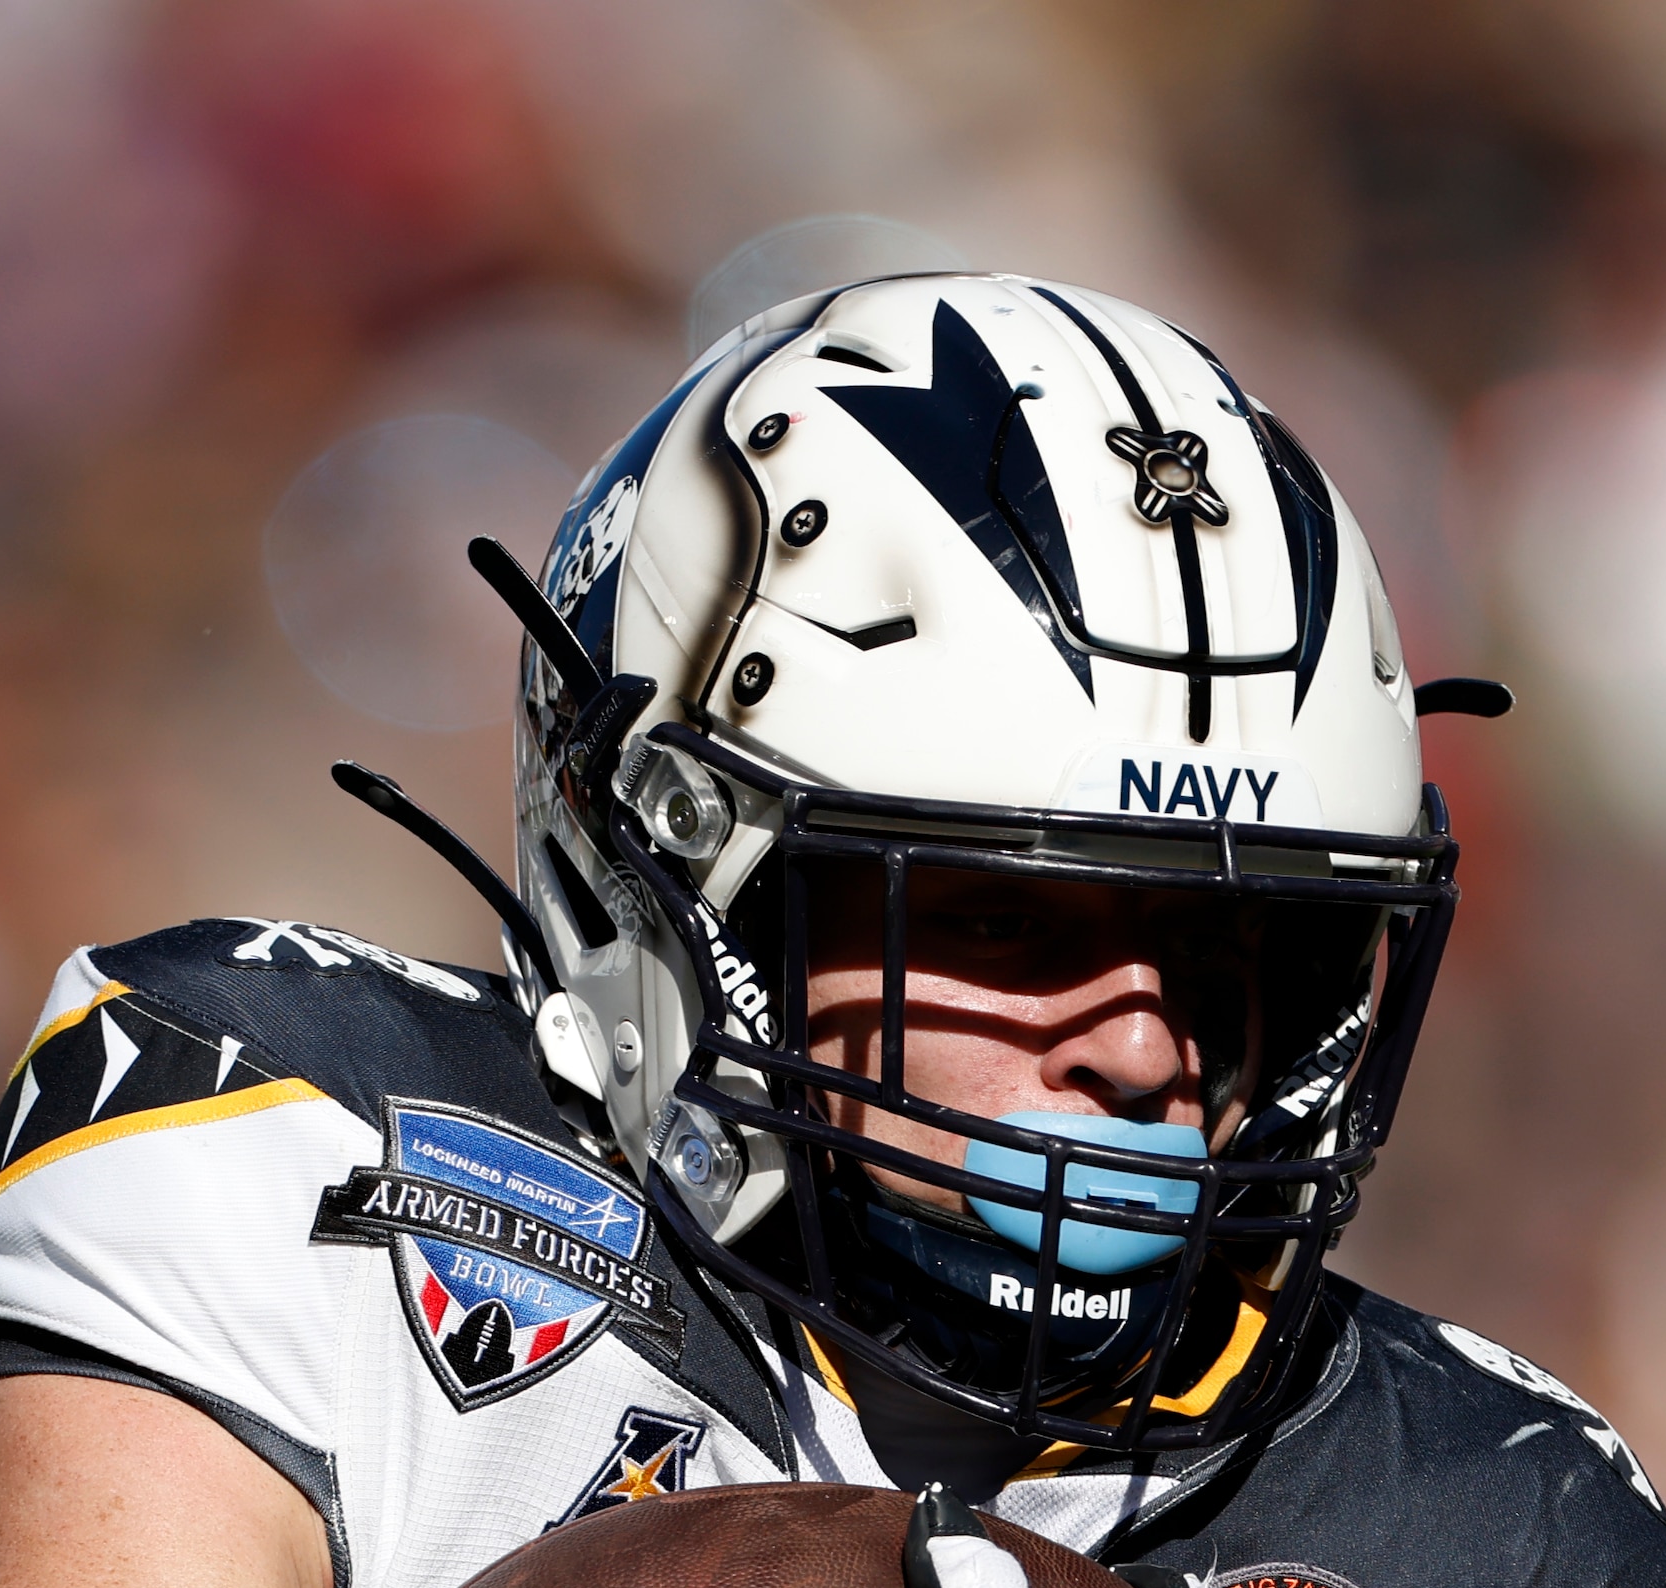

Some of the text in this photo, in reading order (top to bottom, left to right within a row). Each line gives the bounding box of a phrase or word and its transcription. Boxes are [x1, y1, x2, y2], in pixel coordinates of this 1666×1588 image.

[1119, 758, 1280, 822] NAVY
[412, 1138, 578, 1214] LOCKHEED MARTIN
[361, 1179, 652, 1309] ARMED FORCES
[449, 1252, 554, 1309] BOWL
